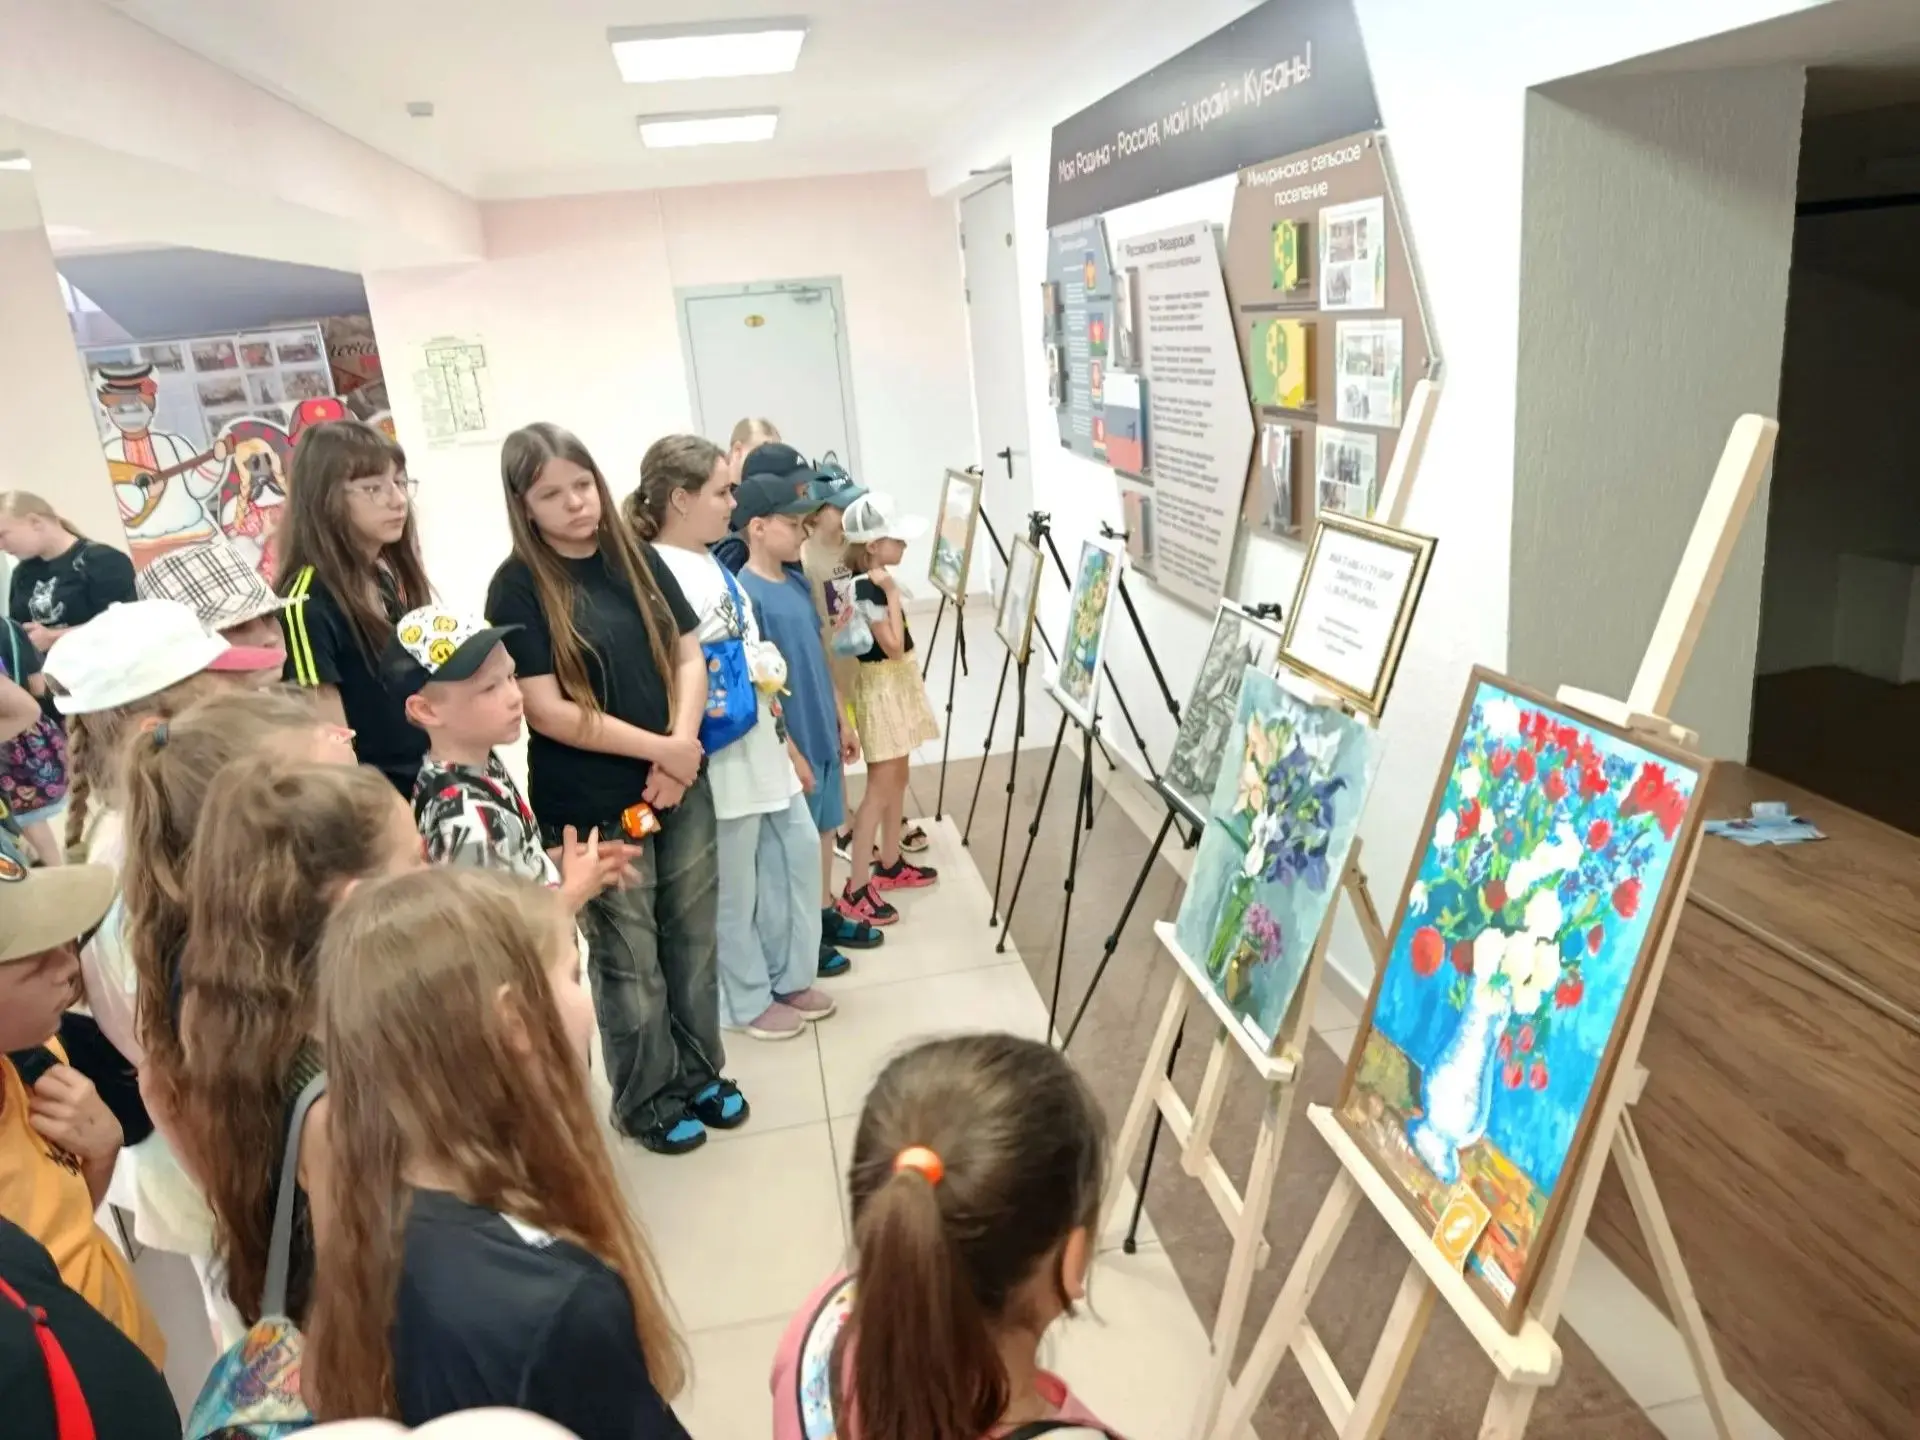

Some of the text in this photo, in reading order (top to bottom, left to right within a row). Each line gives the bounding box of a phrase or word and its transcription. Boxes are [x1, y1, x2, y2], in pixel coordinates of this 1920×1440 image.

[1076, 143, 1111, 176] Родина
[1118, 120, 1161, 160] Россия,
[1163, 101, 1190, 140] мой
[1193, 81, 1230, 132] край
[1244, 40, 1312, 108] Кубань!
[1311, 143, 1362, 172] сельское
[1274, 180, 1329, 207] поселение
